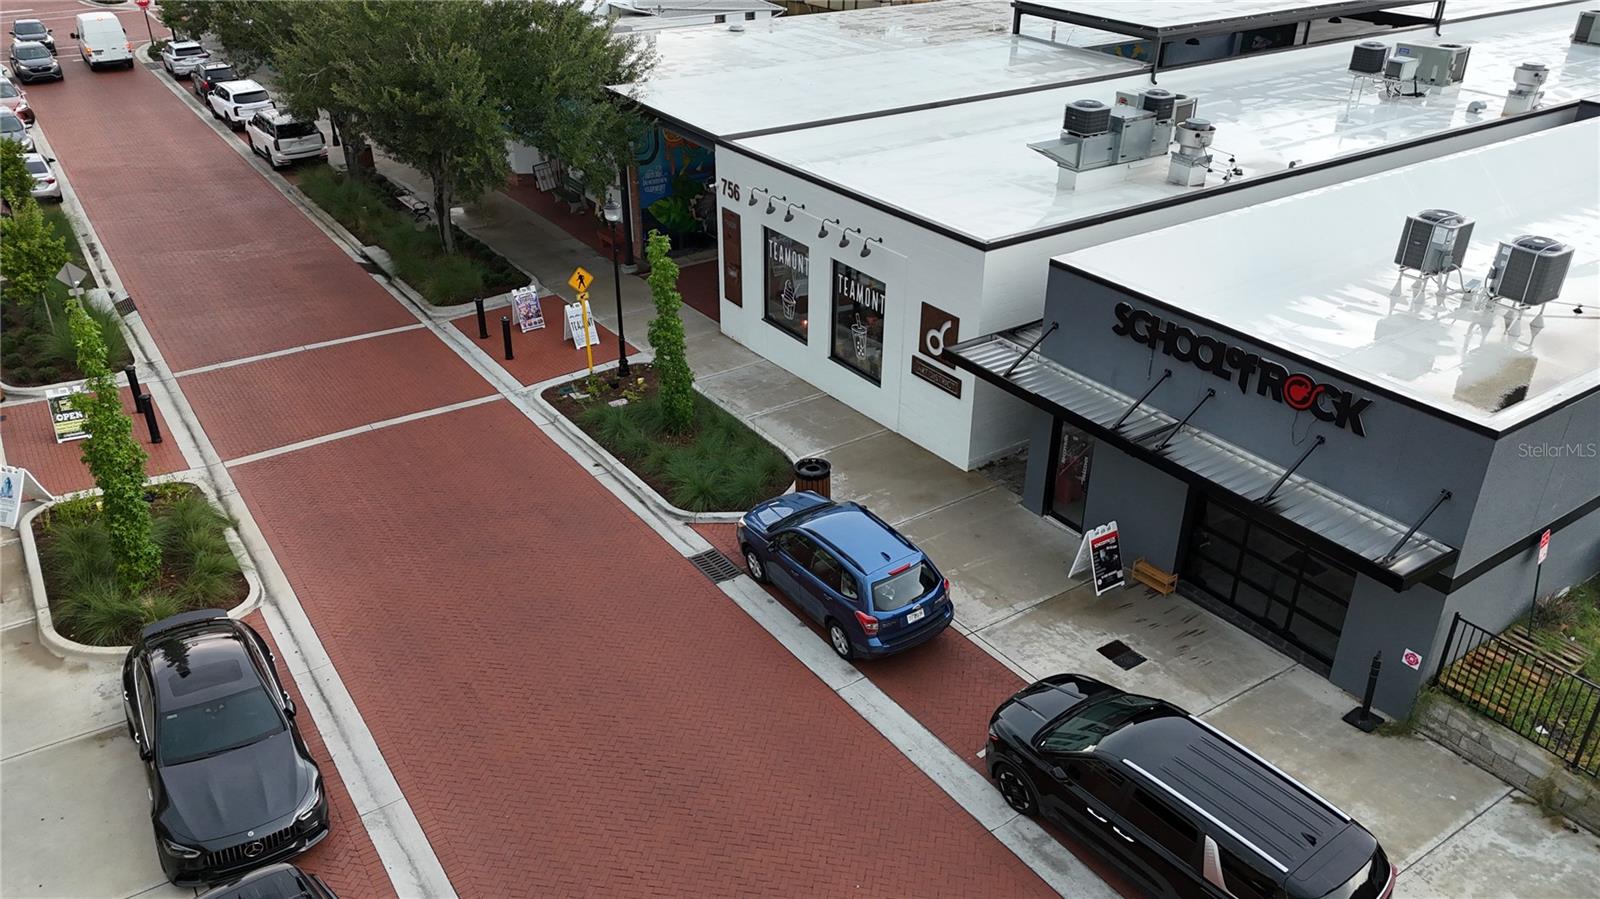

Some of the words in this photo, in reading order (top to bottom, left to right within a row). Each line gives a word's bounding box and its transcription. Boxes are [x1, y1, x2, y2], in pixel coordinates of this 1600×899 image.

[721, 177, 740, 202] 756
[768, 239, 810, 277] TEAMONT
[838, 273, 886, 315] TEAMONT
[1112, 301, 1232, 381] SCHOOL
[1257, 357, 1374, 438] ROCK
[56, 411, 84, 422] OPEN
